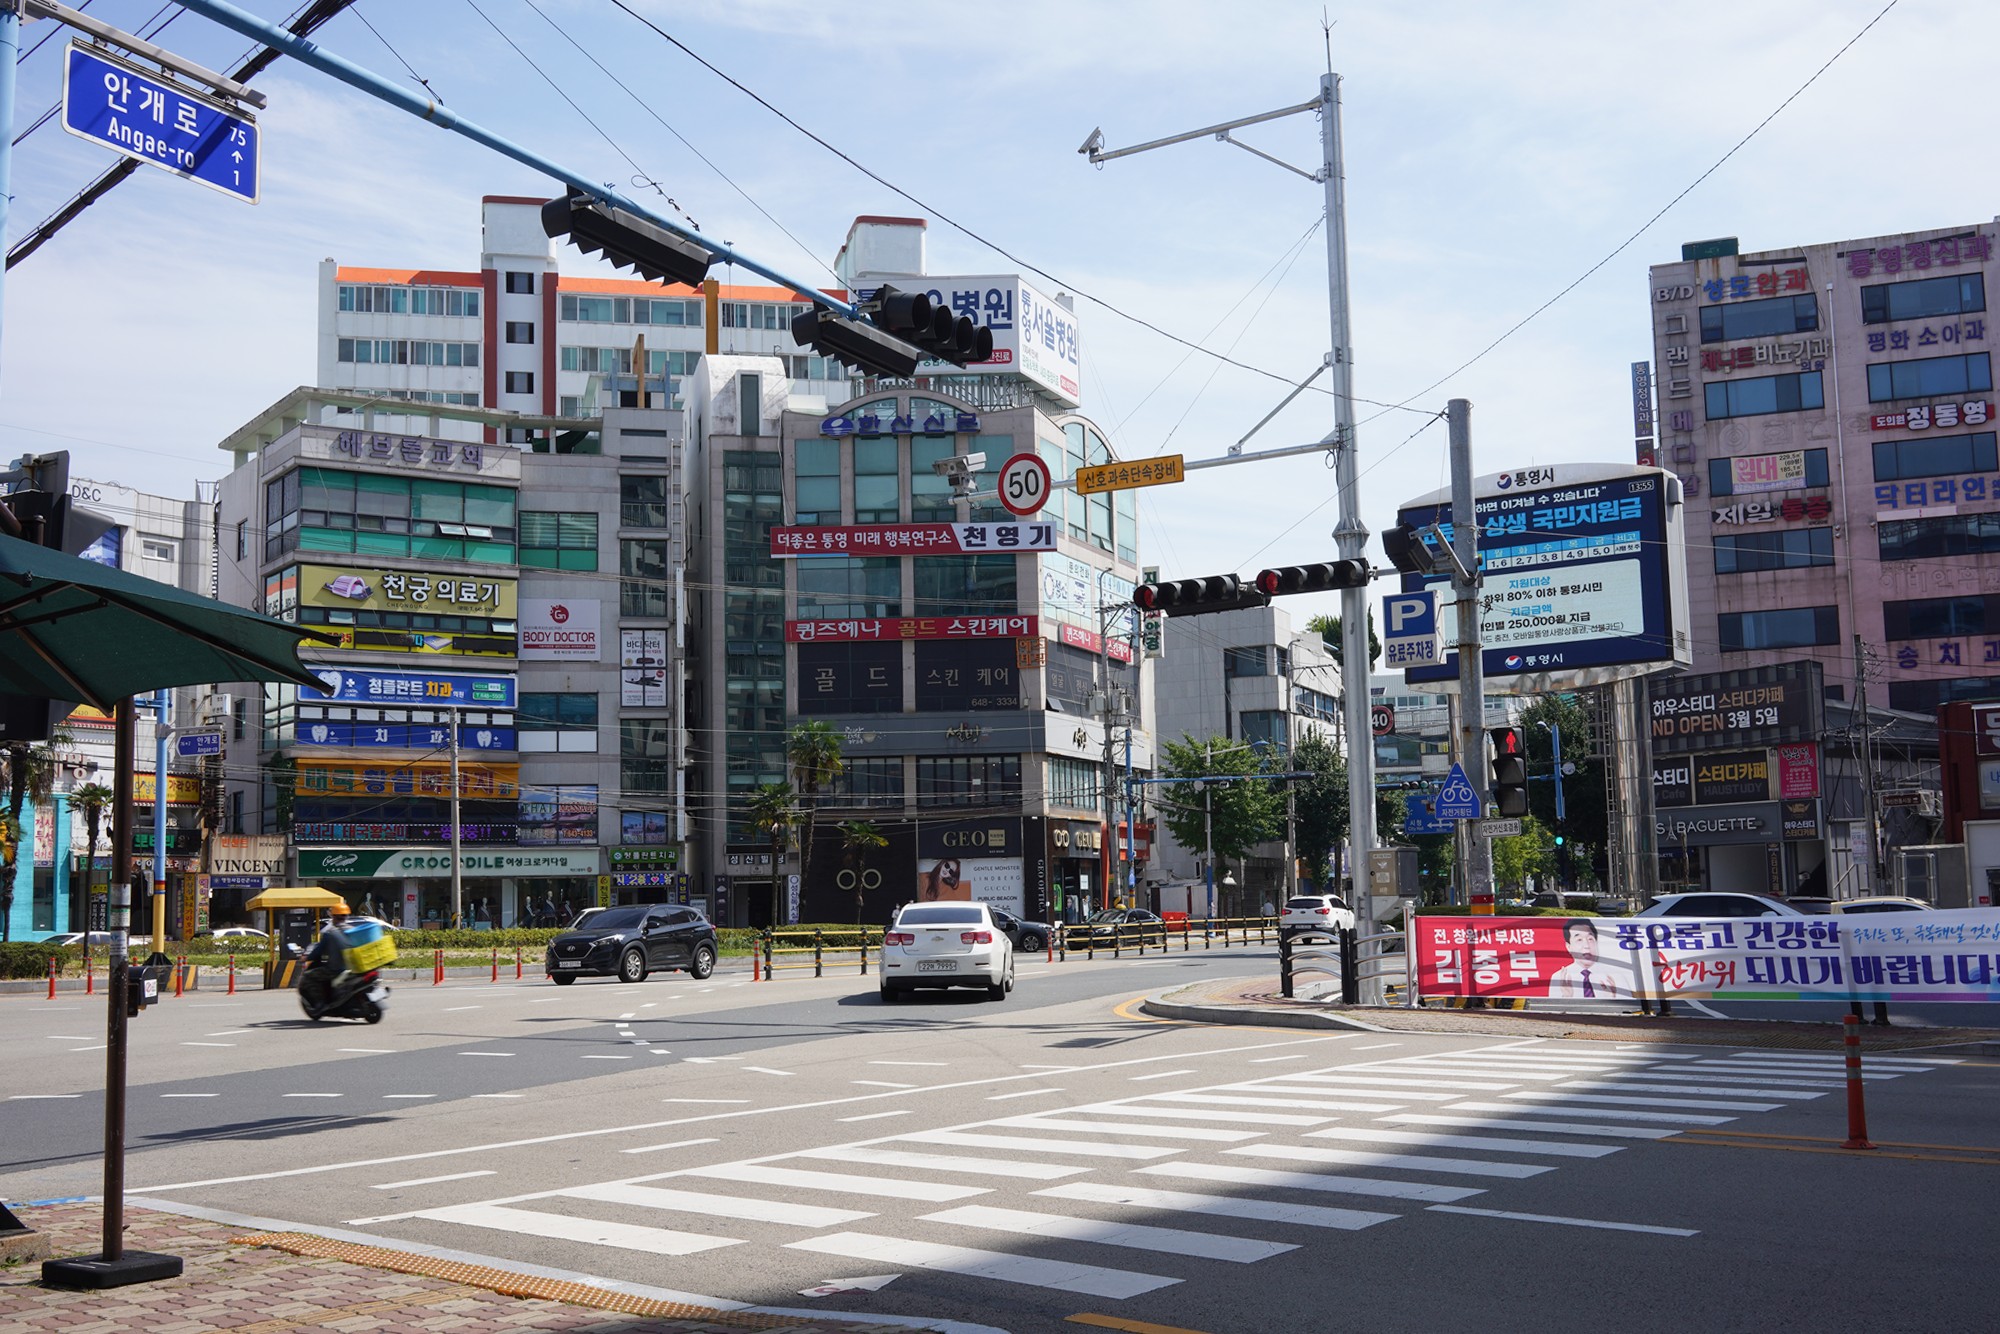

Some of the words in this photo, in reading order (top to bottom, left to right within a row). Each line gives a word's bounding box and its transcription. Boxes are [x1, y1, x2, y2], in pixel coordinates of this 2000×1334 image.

[103, 73, 200, 138] 안개로
[107, 117, 195, 169] Angae-ro
[229, 126, 247, 147] 75
[233, 170, 241, 186] 1
[1846, 234, 1992, 278] 통영정신과
[1867, 330, 1911, 352] 평화
[1917, 319, 1986, 347] 소아과
[857, 412, 979, 434] 한산신문
[1875, 414, 1906, 428] 도의원
[1905, 399, 1988, 431] 정동영
[339, 431, 484, 470] 헤브론교회
[1084, 461, 1177, 490] 신호과속단속장비
[1514, 467, 1555, 487] 통영시
[1735, 456, 1779, 483] 임대
[71, 484, 102, 502] D&C
[1009, 468, 1040, 500] 50
[1874, 477, 1986, 509] 닥터라인
[1501, 494, 1536, 510] 이겨낼
[1538, 493, 1550, 504] 수
[1485, 513, 1527, 537] 상생
[1532, 497, 1642, 531] 국민지원금
[1715, 500, 1777, 526] 제일
[777, 532, 818, 549] 더좋은
[820, 531, 849, 549] 통영
[853, 530, 881, 546] 미래
[884, 530, 953, 547] 행복연구소
[962, 524, 1052, 548] 천영기
[1507, 590, 1533, 601] 80%
[1536, 587, 1557, 598] 이하
[1560, 582, 1603, 595] 통영시민
[1509, 576, 1551, 589] 지원대상
[1391, 600, 1427, 631] P
[1510, 604, 1553, 616] 지급금액
[1569, 612, 1591, 623] 지급
[523, 631, 551, 642] BODY
[554, 631, 595, 642] DOCTOR
[796, 620, 882, 641] 퀸즈헤나
[898, 619, 938, 637] 골드
[947, 617, 1029, 637] 스킨케어
[1388, 642, 1434, 663] 유료주차장
[1525, 653, 1563, 666] 통영시
[368, 678, 424, 696] 청플란트
[425, 681, 454, 698] 치과
[1653, 694, 1716, 716] 하우스터디
[1718, 685, 1785, 708] 스터디카페
[1371, 713, 1389, 728] 40
[1679, 713, 1725, 736] OPEN
[1727, 711, 1751, 730] 3월
[1755, 707, 1779, 727] 5일
[196, 735, 219, 746] 안개로
[1697, 761, 1768, 784] 스터디카페
[1441, 807, 1473, 817] 자전거횡단
[1676, 817, 1758, 835] BAGUETTE
[942, 830, 986, 847] GEO
[214, 859, 284, 872] VINCENT
[401, 856, 504, 869] CROCDILE
[1433, 928, 1450, 944] 전.
[1453, 928, 1492, 944] 창원시
[1495, 928, 1536, 946] 부시장
[1616, 922, 1738, 951] 풍요롭고
[1744, 921, 1842, 950] 건강한
[1852, 926, 1888, 944] 우리는
[1914, 923, 1966, 943] 극복해낼
[1434, 949, 1541, 986] 김종부
[1652, 950, 1736, 990] 한가위
[1745, 955, 1844, 985] 되시기
